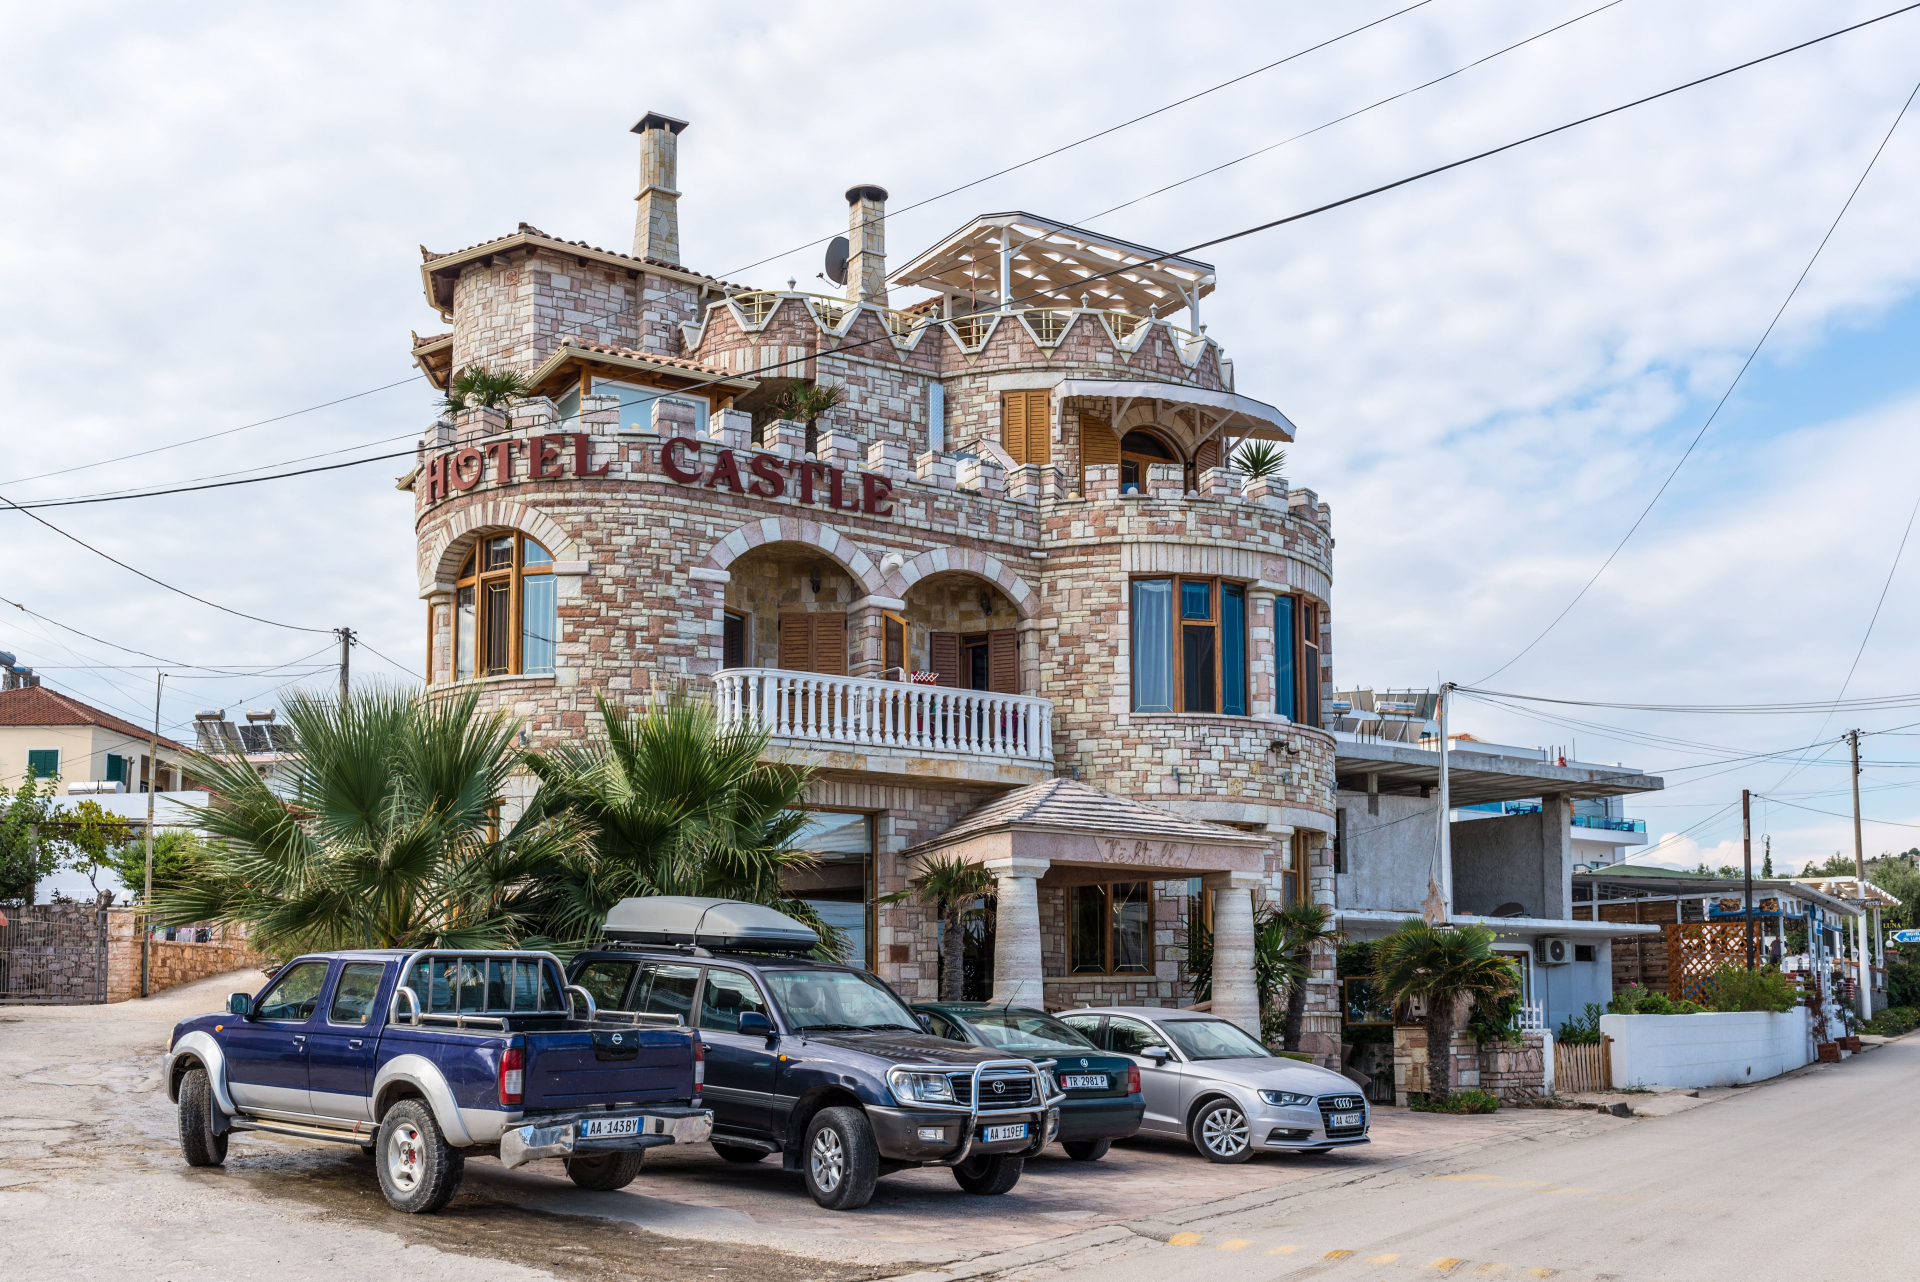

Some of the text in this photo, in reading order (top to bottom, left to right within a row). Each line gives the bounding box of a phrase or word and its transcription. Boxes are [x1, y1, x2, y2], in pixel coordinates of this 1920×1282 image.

[425, 433, 894, 517] HOTEL CASTLE
[1068, 1076, 1105, 1086] TR 2981 P
[590, 1119, 638, 1135] AA 143BY
[1335, 1116, 1343, 1125] AA
[990, 1125, 1024, 1140] AA 119EF
